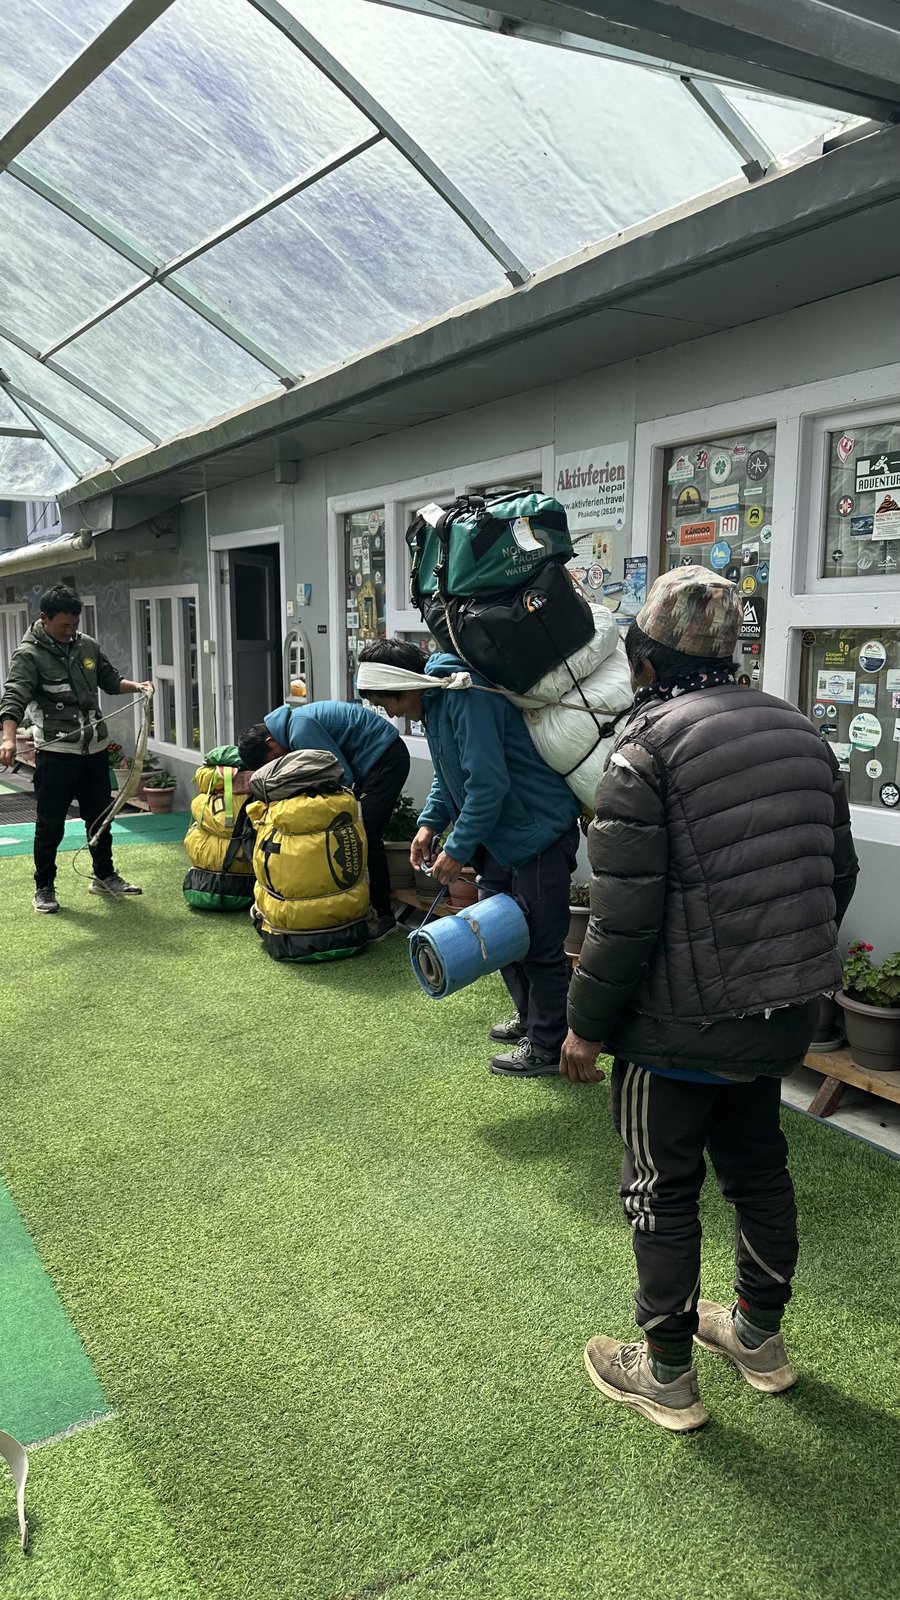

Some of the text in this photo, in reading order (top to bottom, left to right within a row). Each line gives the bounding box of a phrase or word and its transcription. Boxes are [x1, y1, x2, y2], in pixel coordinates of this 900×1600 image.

[557, 461, 626, 491] Aktivferien
[599, 482, 626, 494] Nepal
[578, 510, 600, 519] Phakding
[617, 506, 625, 515] m)
[512, 551, 539, 565] FACE
[505, 564, 533, 577] WATER
